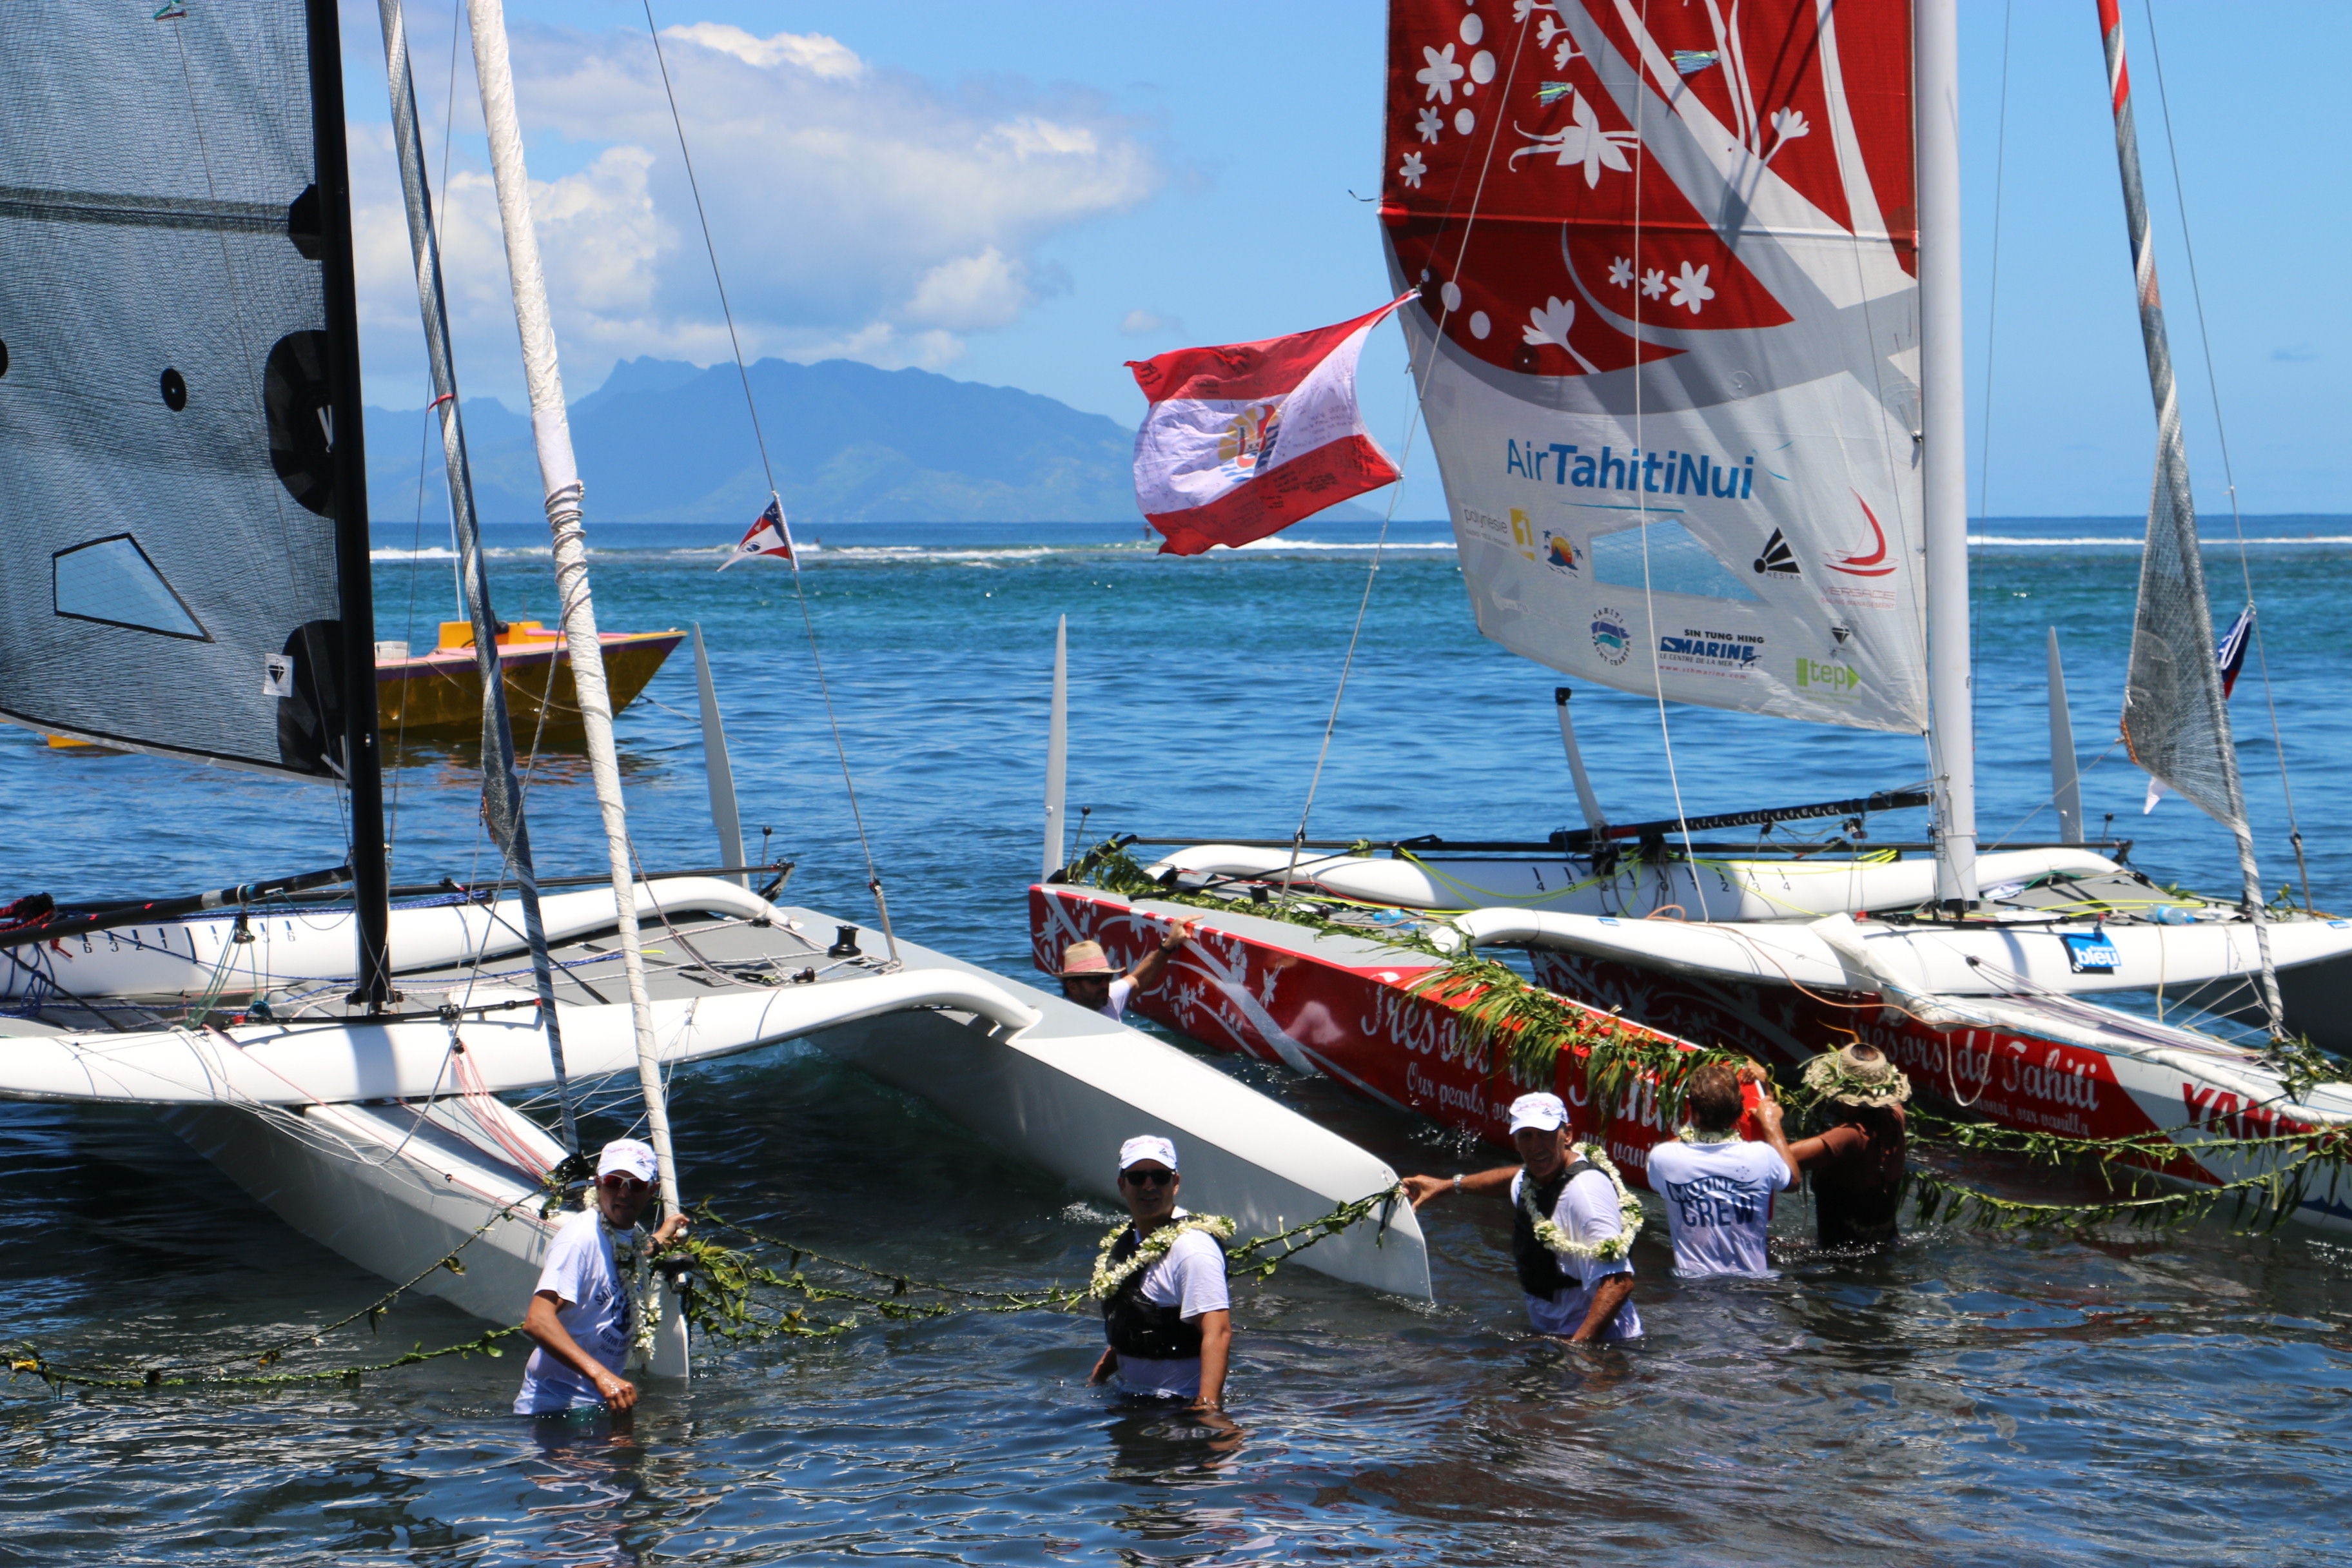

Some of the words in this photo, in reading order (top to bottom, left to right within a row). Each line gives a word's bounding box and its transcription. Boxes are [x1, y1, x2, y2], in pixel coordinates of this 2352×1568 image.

[1821, 585, 1896, 601] VERSACE
[1593, 607, 1624, 624] TAHITI
[1684, 629, 1701, 638] SIN
[1705, 631, 1734, 641] TUNG
[1738, 634, 1765, 644] HING
[1678, 638, 1755, 661] MARINE
[1669, 654, 1694, 663] CENTRE
[1718, 659, 1734, 667] MER
[1658, 665, 1747, 680] www.sthmarine.com
[1536, 881, 1545, 892] 4
[1721, 881, 1730, 892] 2
[1782, 881, 1792, 892] 4
[82, 941, 93, 954] 6
[108, 941, 120, 952] 3
[161, 939, 168, 949] 1
[286, 931, 296, 942] 6
[2073, 947, 2121, 965] bleu
[1406, 1061, 1436, 1099] Our
[1957, 1030, 1992, 1086] de
[2002, 1041, 2101, 1112] Tahiti
[1668, 1177, 1736, 1202] MUTINY
[1680, 1193, 1754, 1228] CREW
